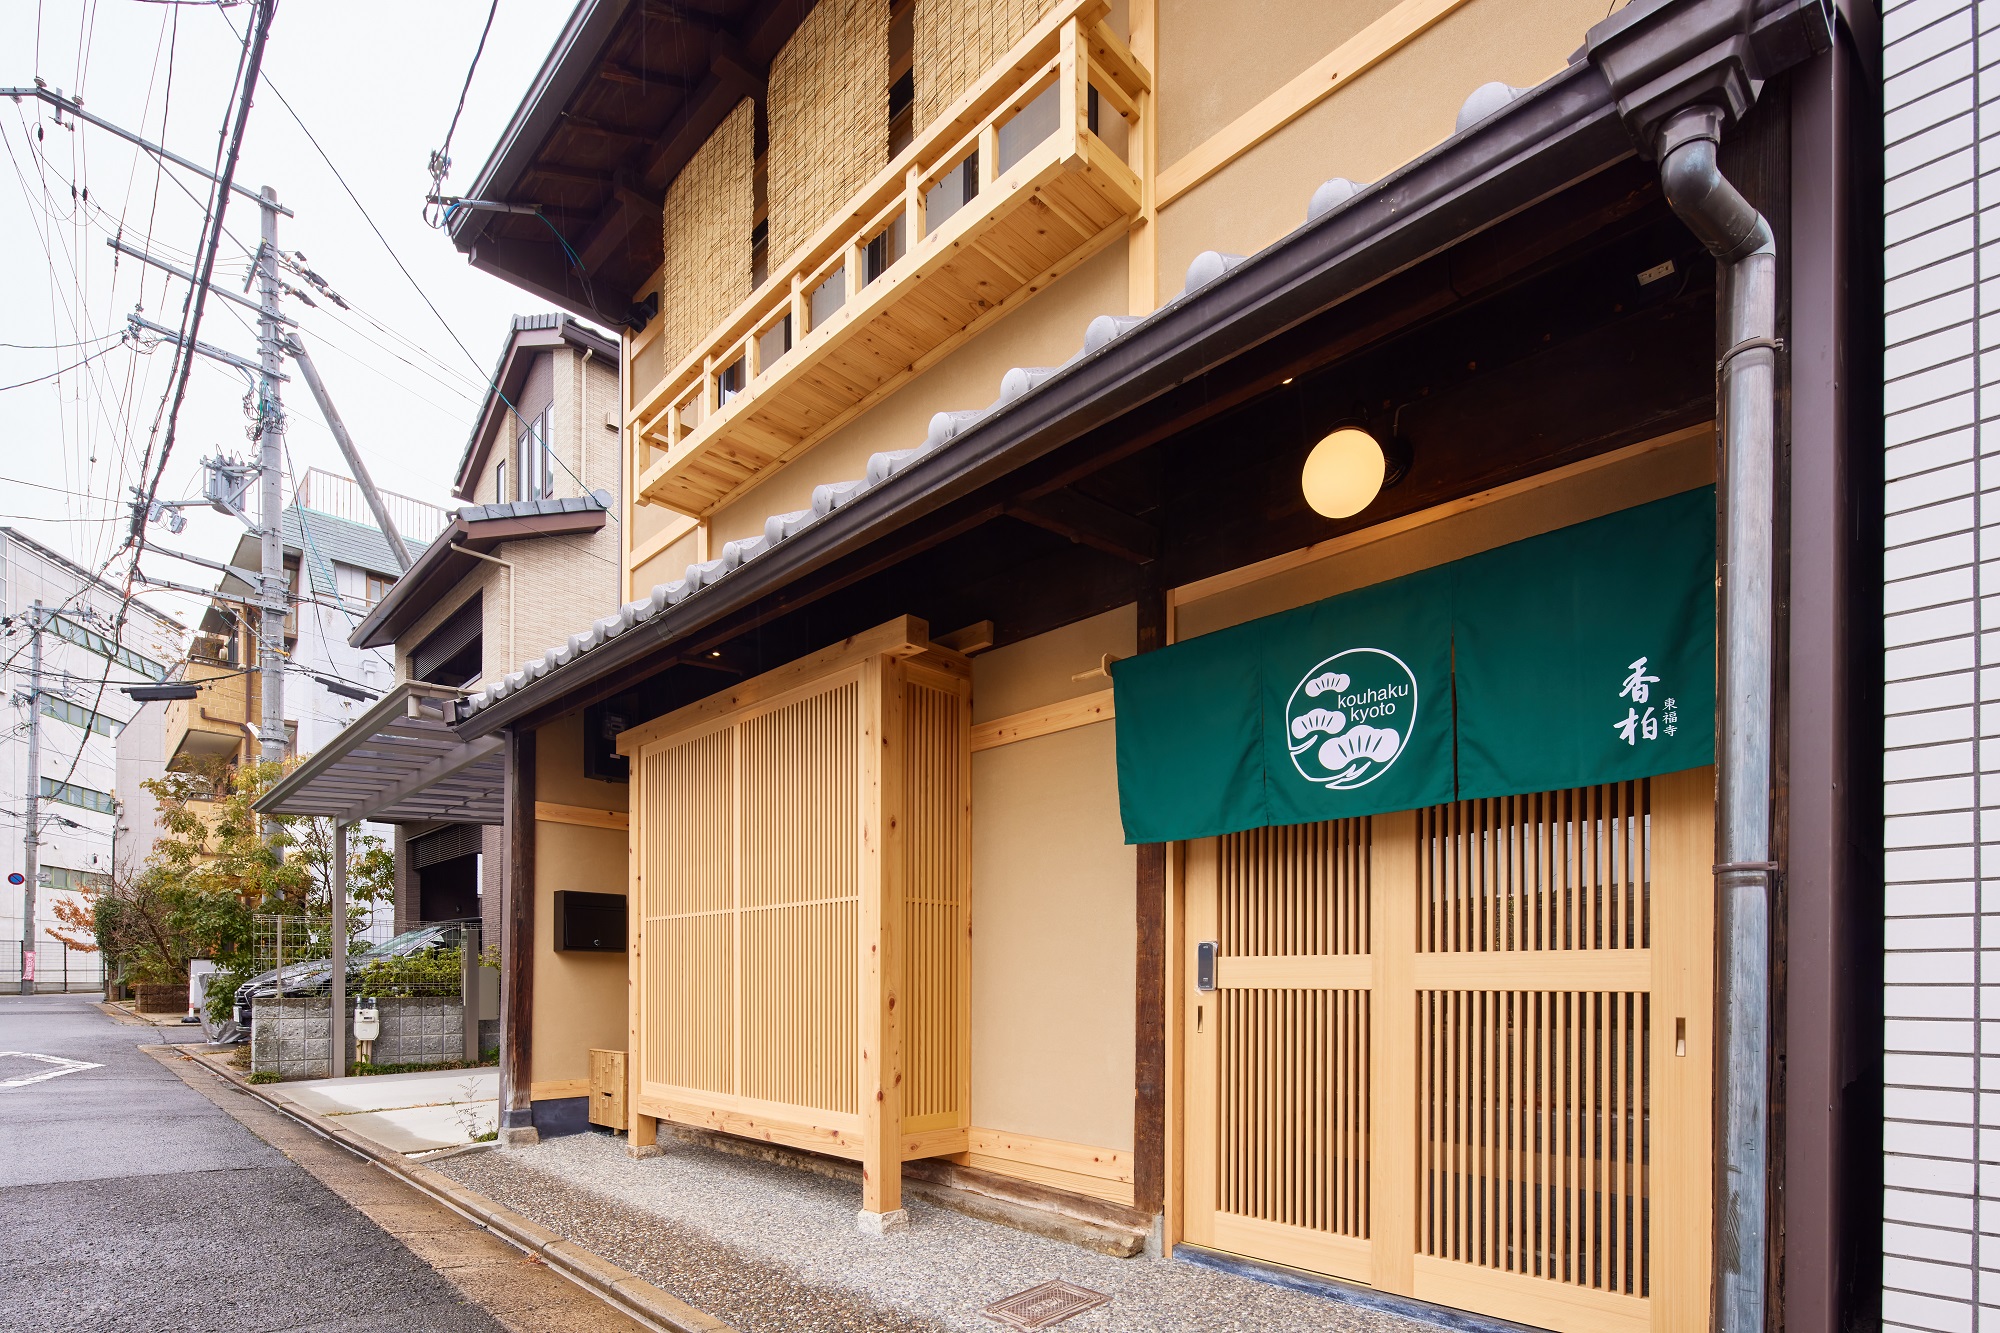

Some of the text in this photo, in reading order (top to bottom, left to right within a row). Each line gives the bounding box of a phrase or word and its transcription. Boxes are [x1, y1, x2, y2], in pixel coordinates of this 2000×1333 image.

[1337, 683, 1408, 709] kouhaku
[1613, 656, 1661, 746] 香柏
[1350, 702, 1396, 724] kyoto
[1662, 697, 1678, 737] 東福寺
